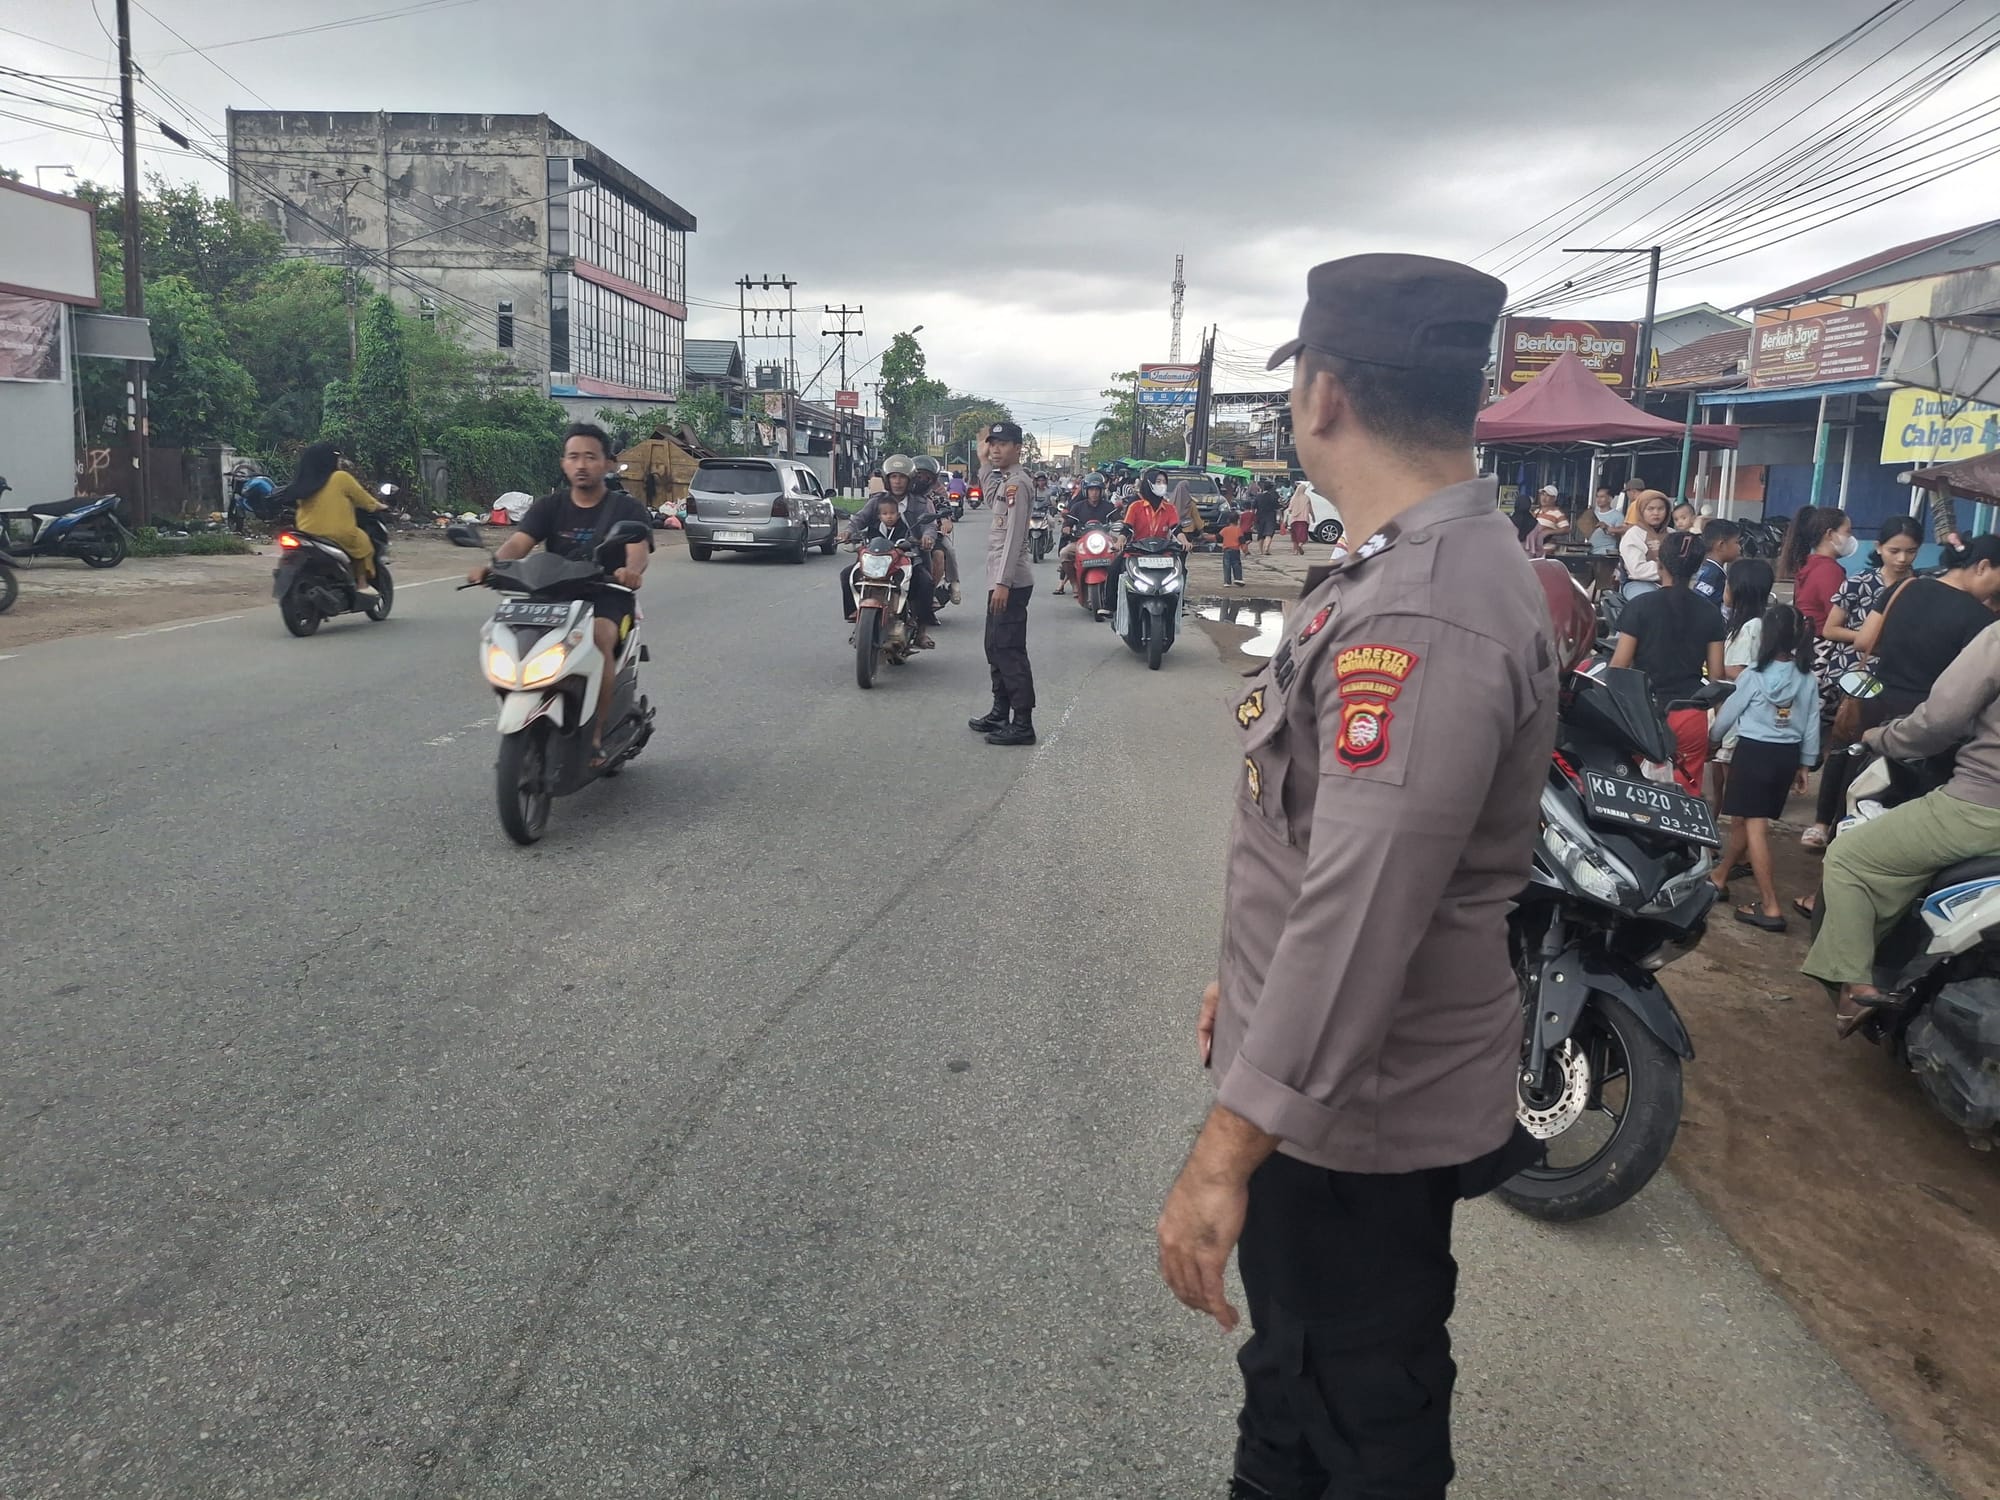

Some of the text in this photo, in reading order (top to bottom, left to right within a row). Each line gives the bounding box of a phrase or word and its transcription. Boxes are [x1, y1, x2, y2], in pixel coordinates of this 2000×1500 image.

[1515, 333, 1625, 358] Berkah Jaya
[1760, 326, 1793, 351] Berkah
[1794, 324, 1821, 347] Jaya
[1901, 421, 1974, 453] Cahaya
[1338, 647, 1409, 668] POLRESTA
[1591, 776, 1616, 797] KB
[1625, 786, 1672, 811] 4920
[1602, 807, 1630, 819] YAMAHA
